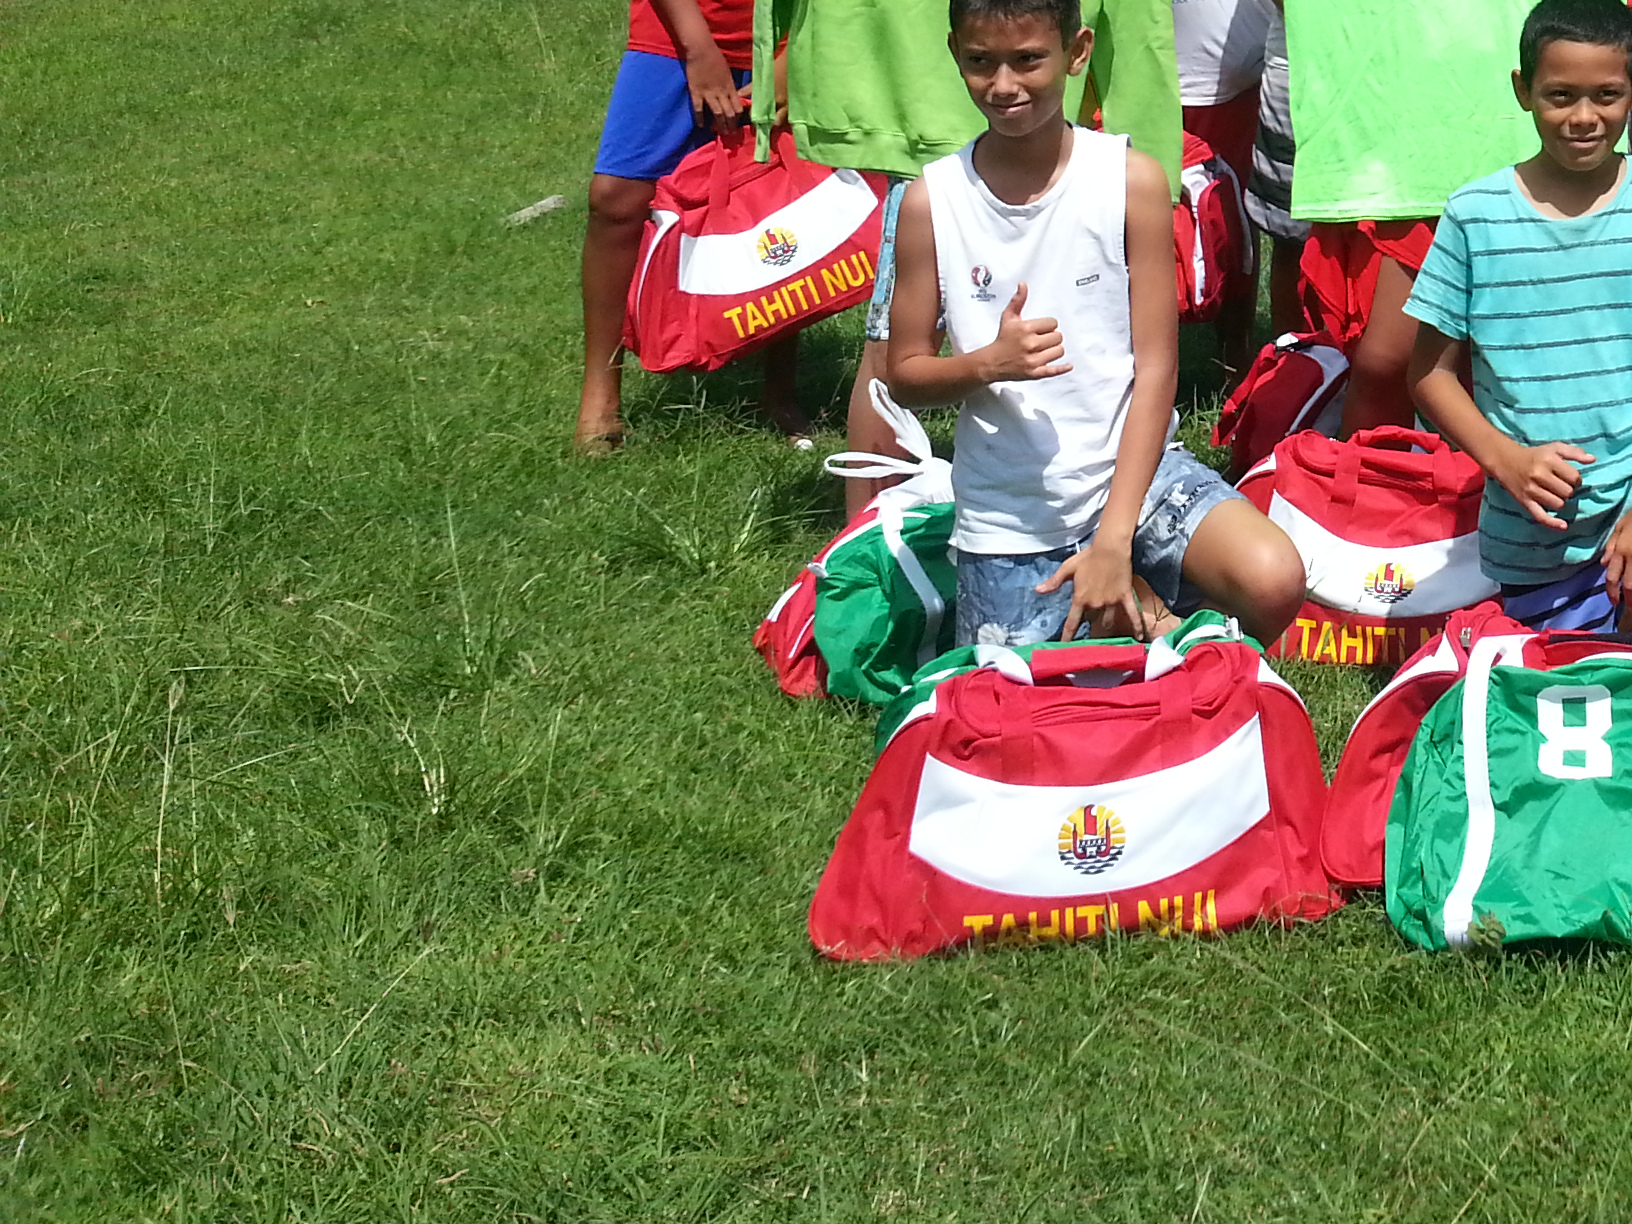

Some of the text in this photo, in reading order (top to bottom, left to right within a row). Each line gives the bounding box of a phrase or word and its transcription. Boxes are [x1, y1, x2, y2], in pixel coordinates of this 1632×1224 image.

[723, 250, 875, 338] TAHITI NUI
[1296, 618, 1406, 664] TAHITI
[1536, 684, 1614, 780] 8
[963, 889, 1218, 948] TAHITI NUI
